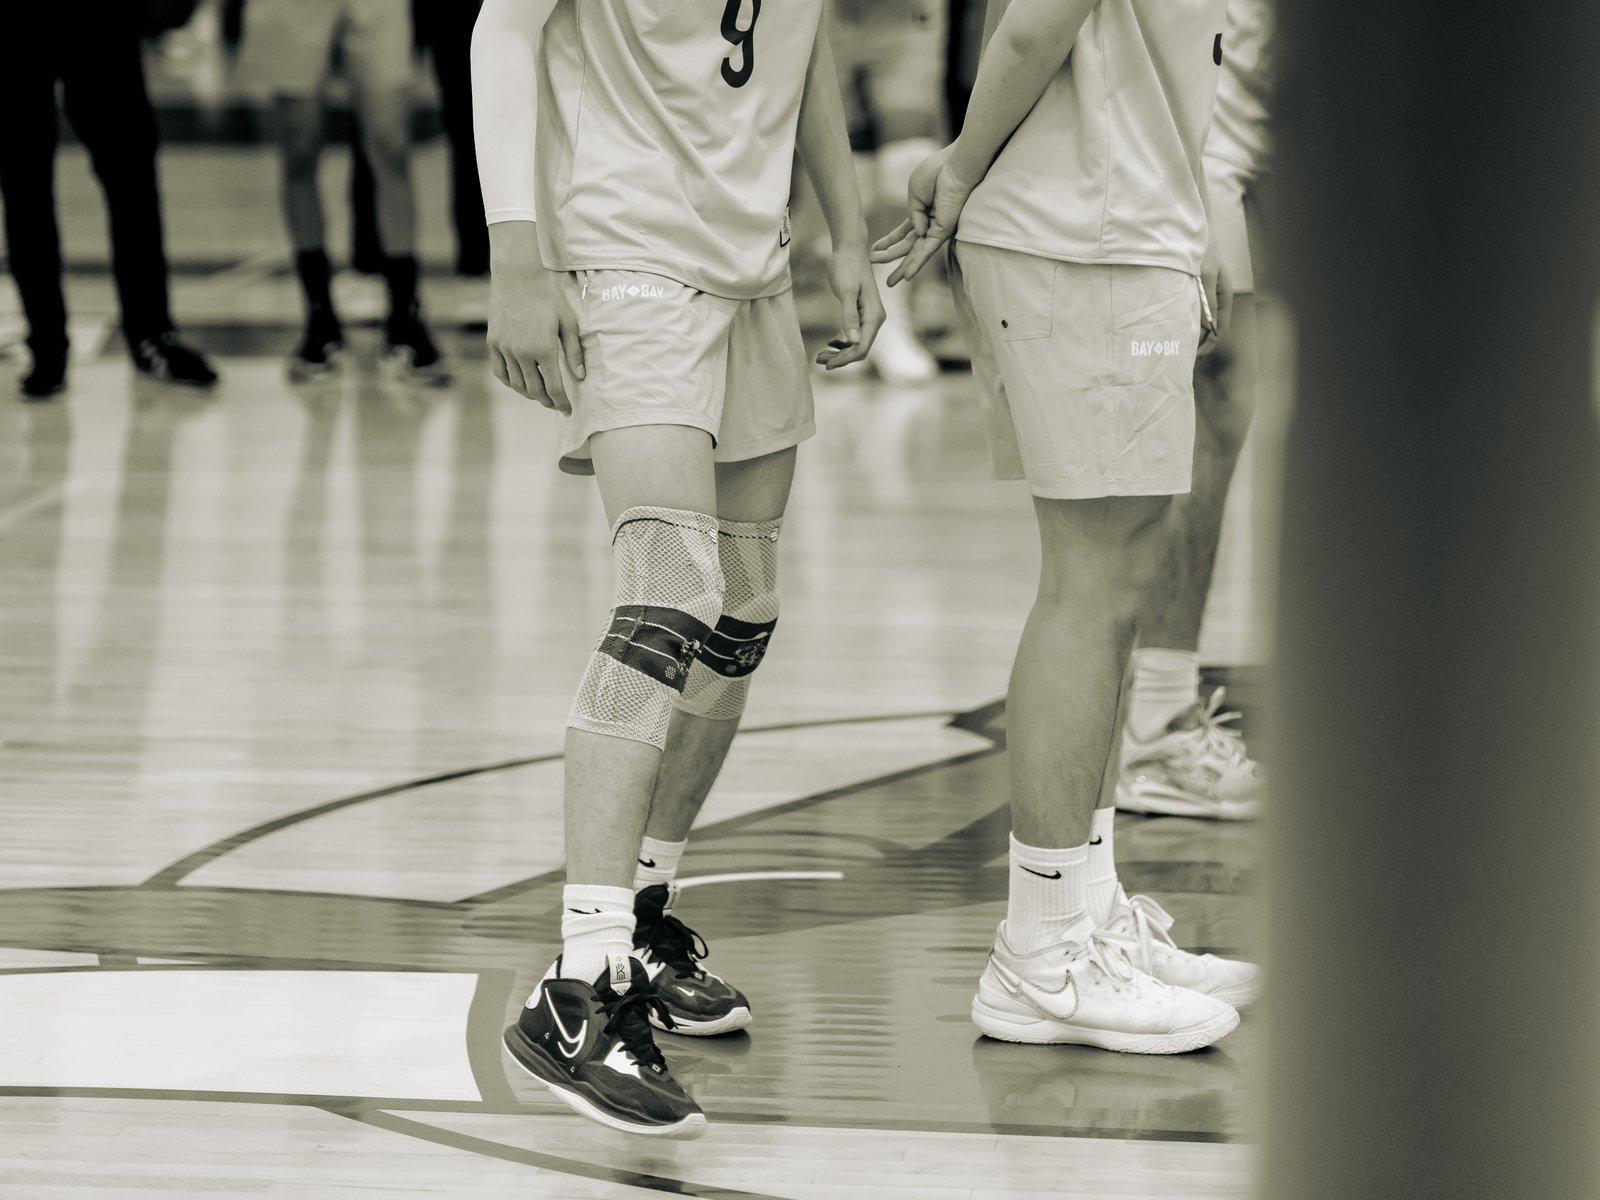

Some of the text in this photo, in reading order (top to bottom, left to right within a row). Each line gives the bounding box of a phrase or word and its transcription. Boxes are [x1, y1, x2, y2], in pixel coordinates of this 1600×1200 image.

[602, 284, 664, 301] BAY BAY
[1131, 340, 1180, 356] BAY BAY
